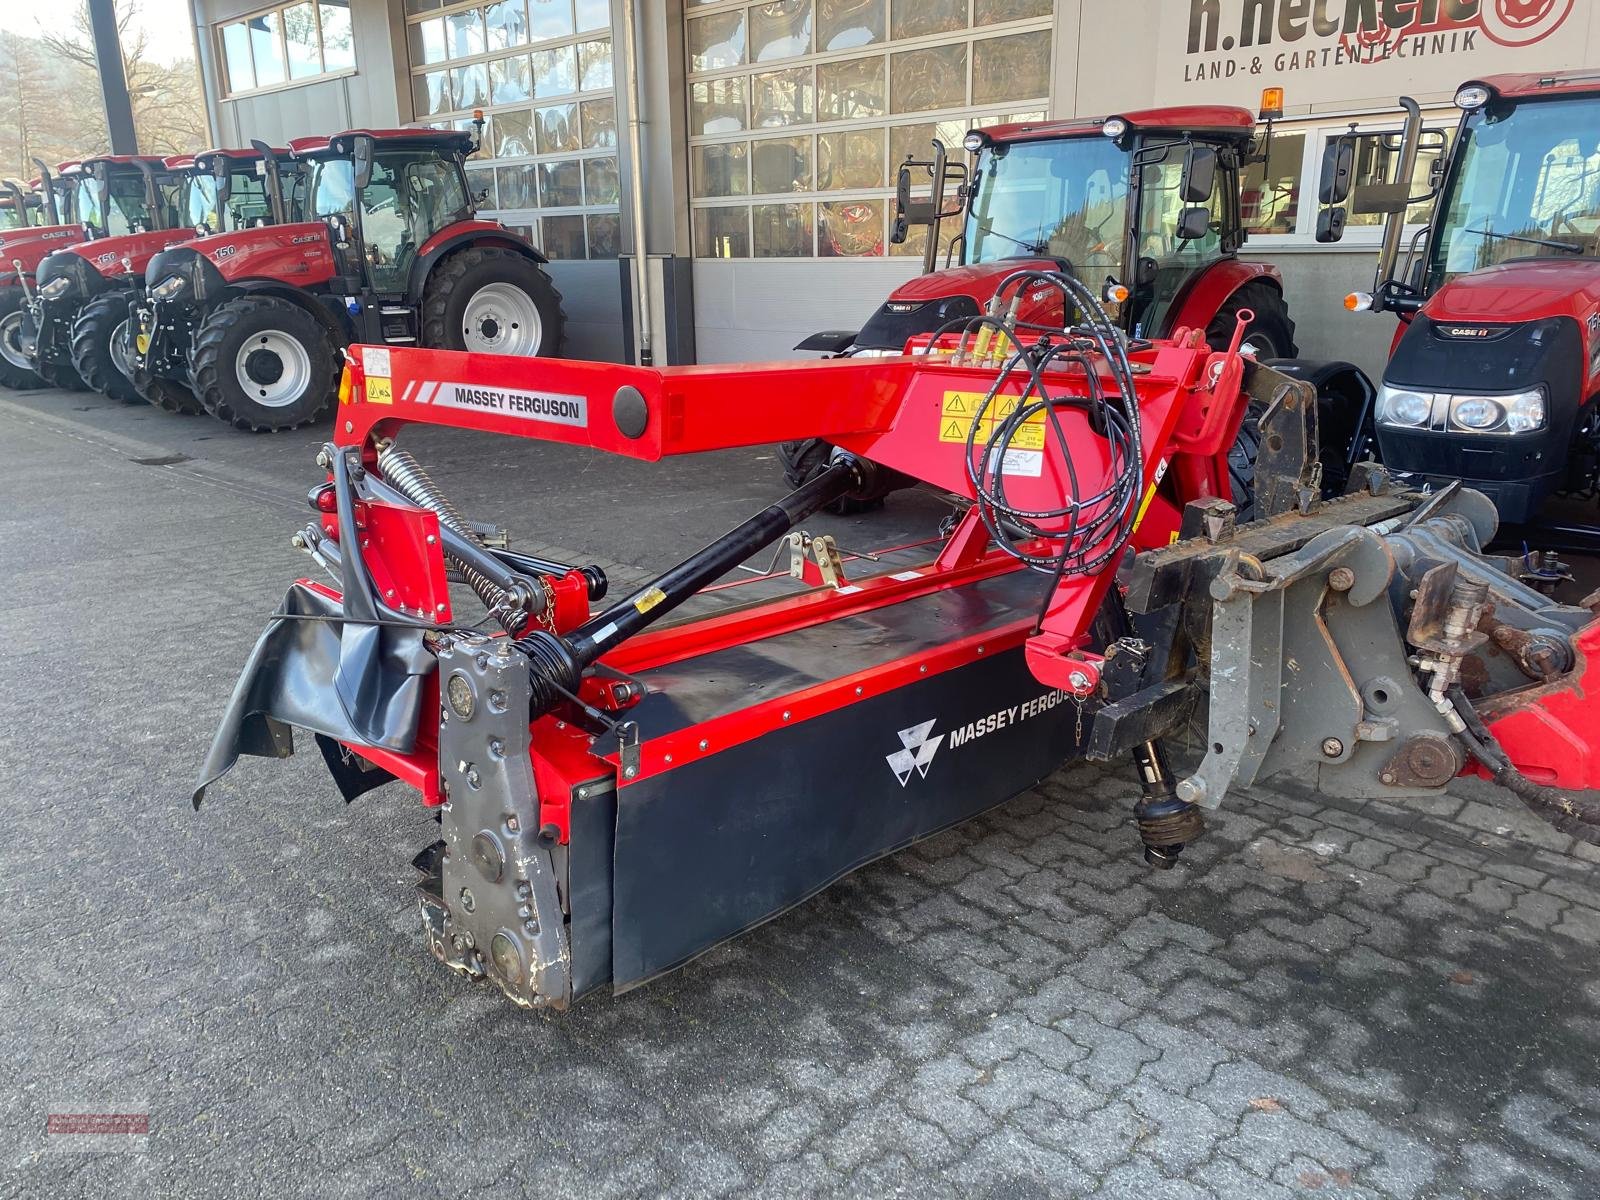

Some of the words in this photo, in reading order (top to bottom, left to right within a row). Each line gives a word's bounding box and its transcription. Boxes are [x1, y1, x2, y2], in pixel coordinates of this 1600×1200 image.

[1275, 30, 1478, 72] GARTENTECHNIK
[98, 252, 116, 264] 150
[215, 245, 236, 260] 150
[455, 387, 505, 409] MASSEY
[509, 394, 579, 419] FERGUSON
[950, 706, 1018, 750] MASSEY
